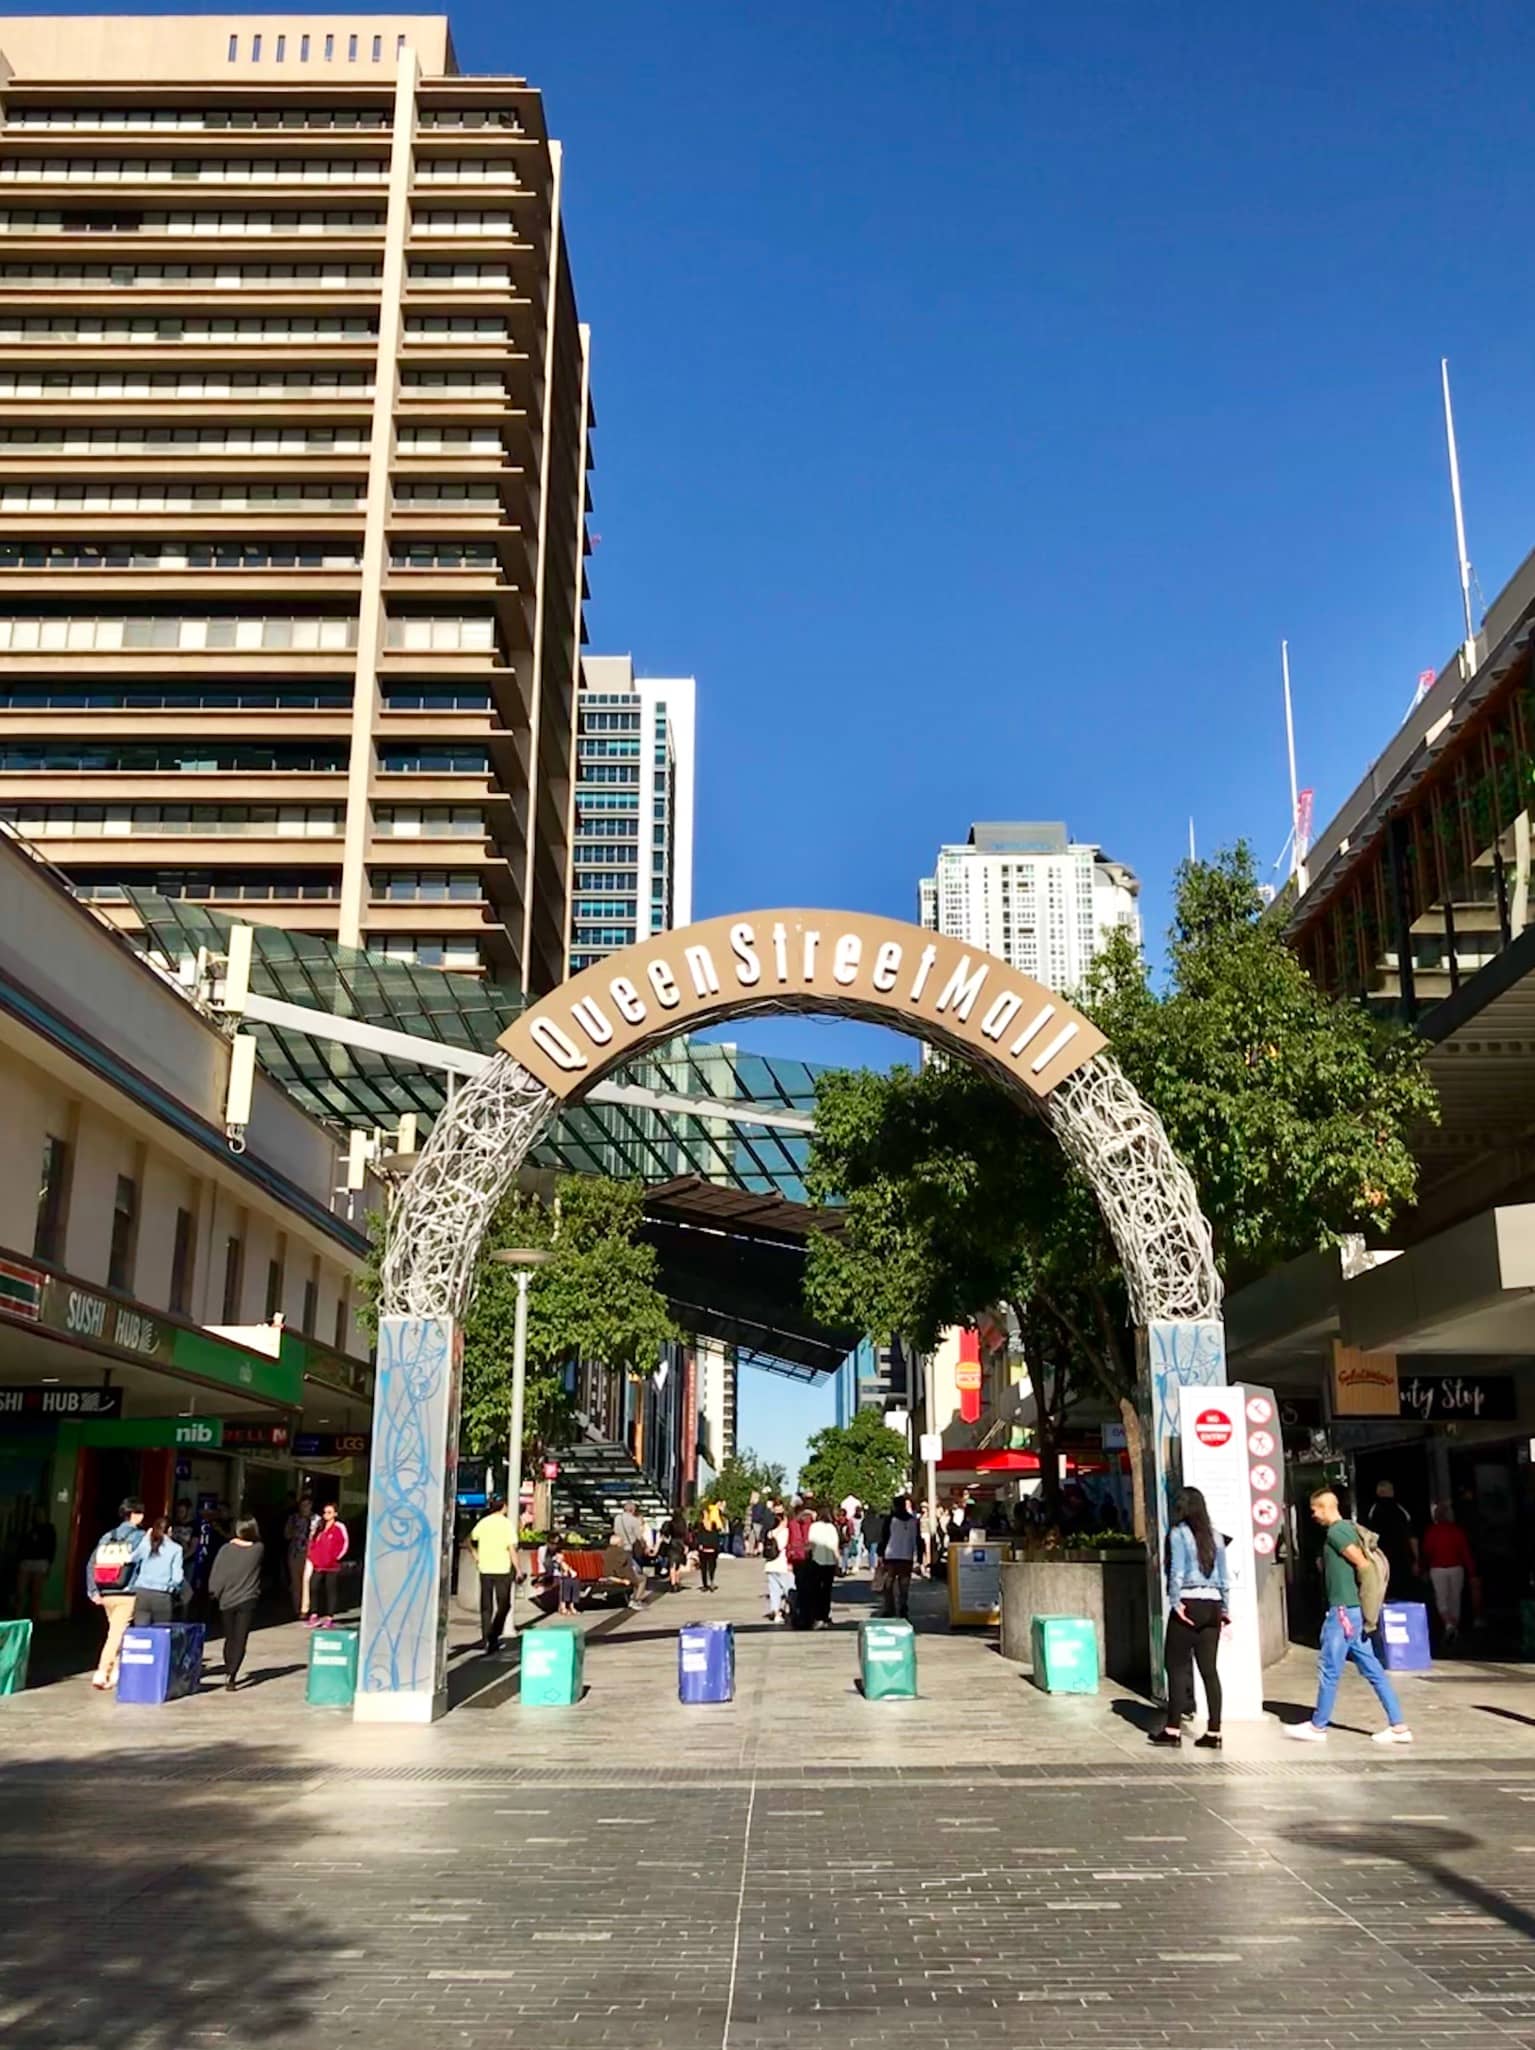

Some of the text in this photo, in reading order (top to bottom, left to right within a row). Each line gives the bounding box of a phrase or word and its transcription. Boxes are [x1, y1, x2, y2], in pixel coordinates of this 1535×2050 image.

[529, 922, 1080, 1075] Queen Street Mall
[66, 1291, 141, 1350] SUSHI HUB
[42, 1391, 79, 1412] HUB
[1441, 1378, 1485, 1416] Stop
[175, 1423, 213, 1443] nib
[335, 1437, 366, 1450] UGG
